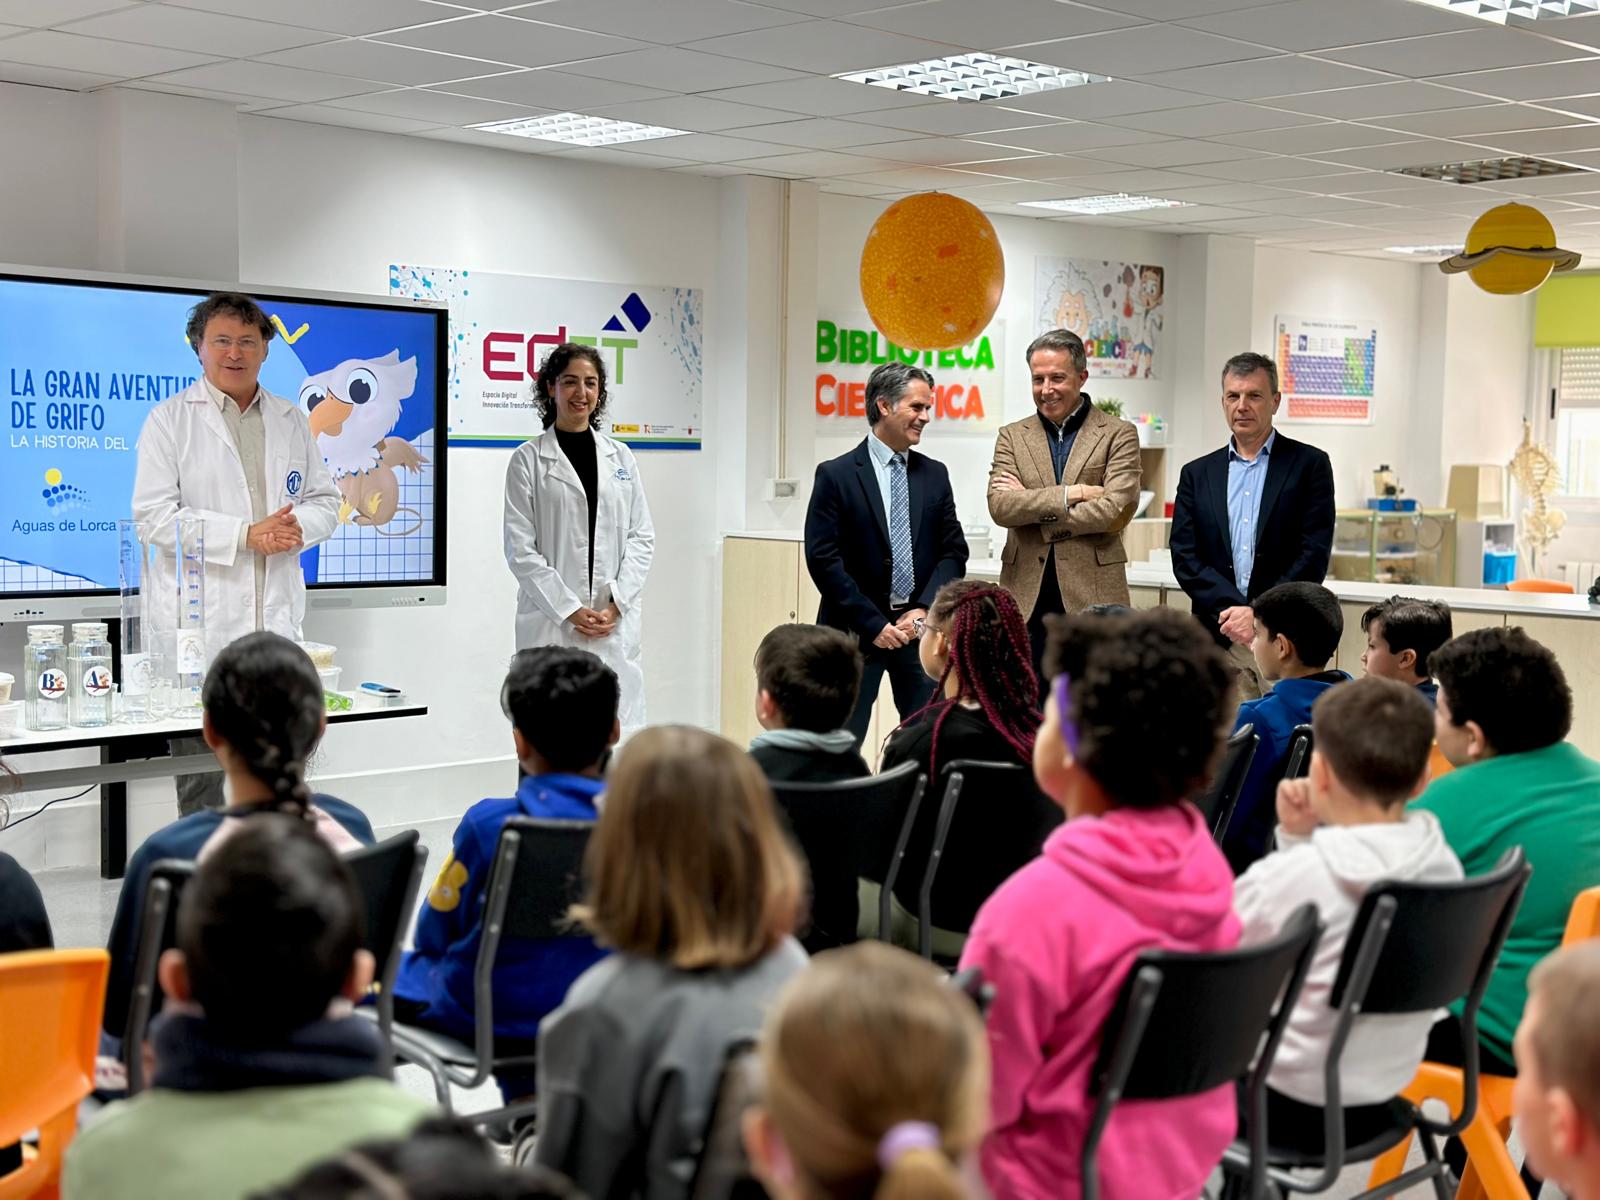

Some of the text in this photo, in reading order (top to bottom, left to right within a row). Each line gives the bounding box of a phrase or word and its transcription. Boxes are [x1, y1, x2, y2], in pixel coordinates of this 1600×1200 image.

[11, 368, 36, 397] LA
[45, 369, 100, 399] GRAN
[482, 391, 518, 400] Espacio Digital
[816, 373, 984, 419] CIEICA
[11, 401, 105, 431] DE GRIFO
[11, 434, 30, 448] LA
[34, 435, 100, 449] HISTORIA
[104, 437, 129, 450] DEL
[12, 519, 117, 535] Aguas de Lorca
